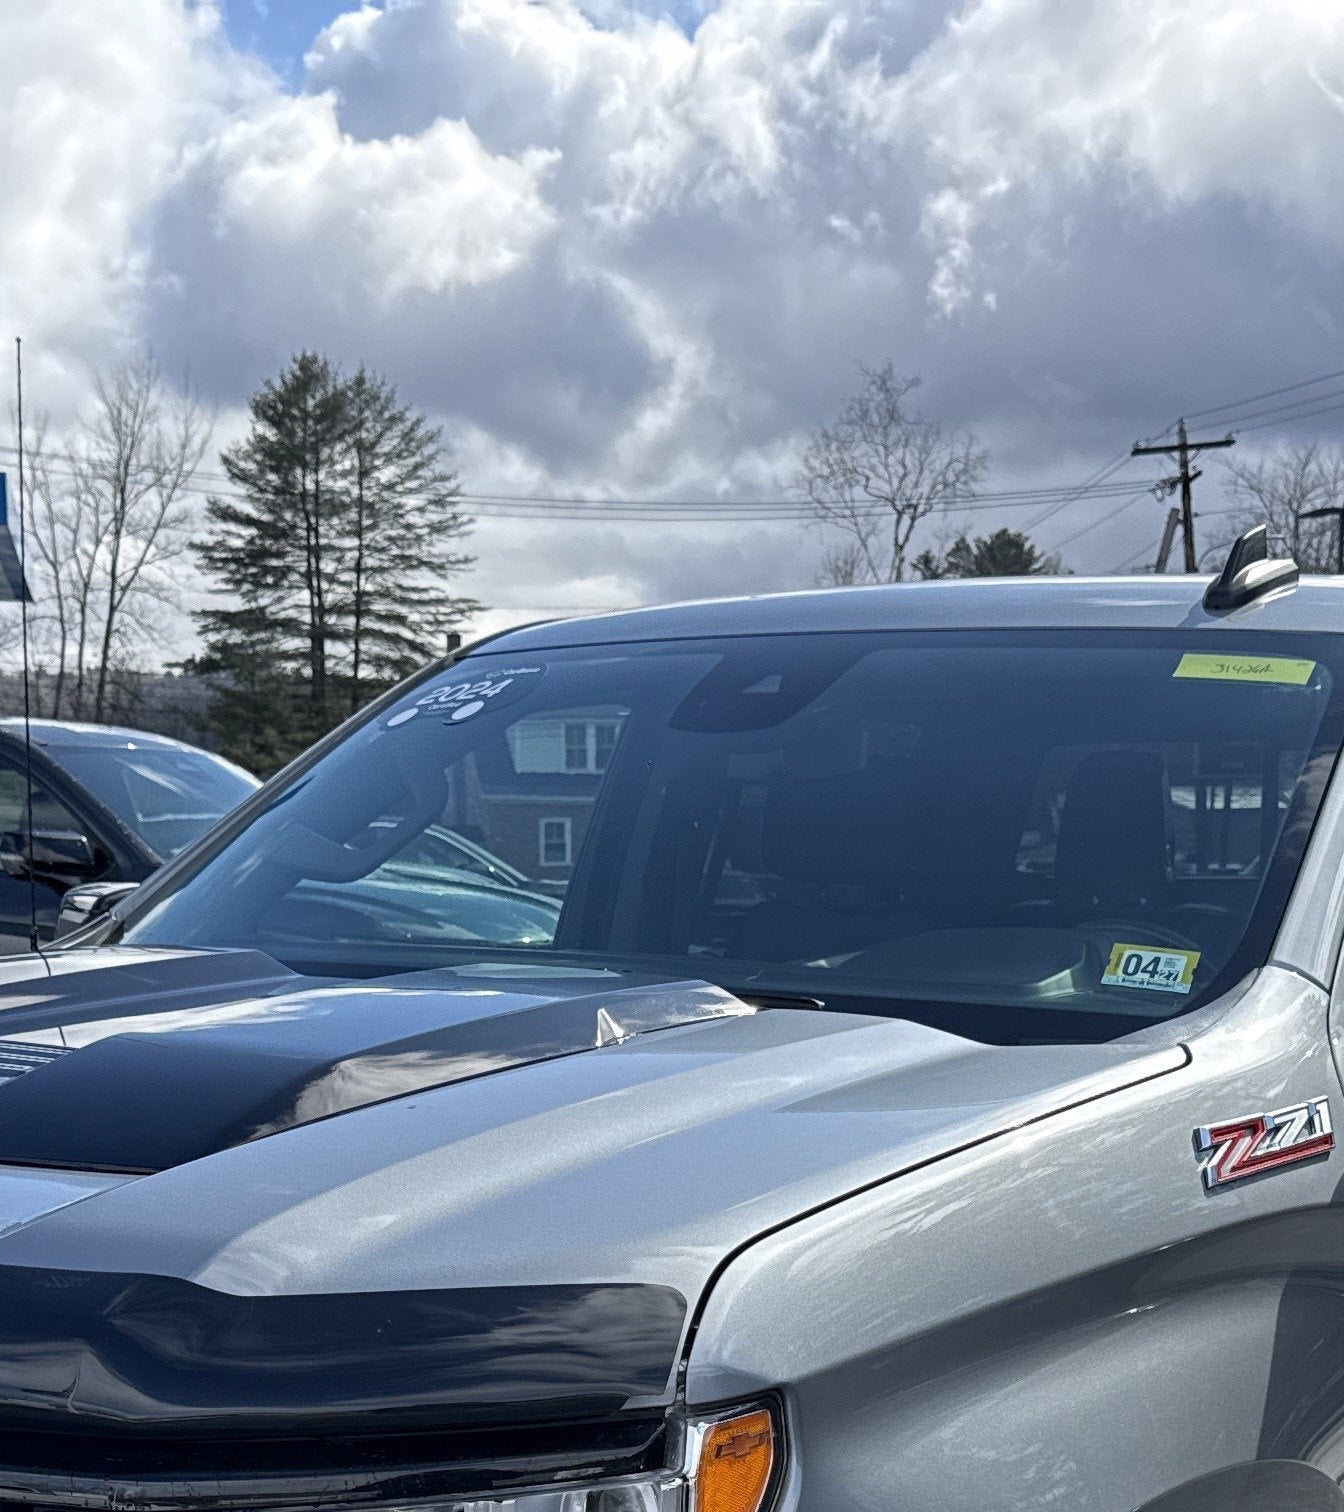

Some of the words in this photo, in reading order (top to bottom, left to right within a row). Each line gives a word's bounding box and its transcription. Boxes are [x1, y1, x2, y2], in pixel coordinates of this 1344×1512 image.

[416, 679, 514, 705] 2024
[1122, 953, 1161, 978] 04
[1159, 969, 1180, 982] 27
[1191, 1095, 1336, 1189] Z71
